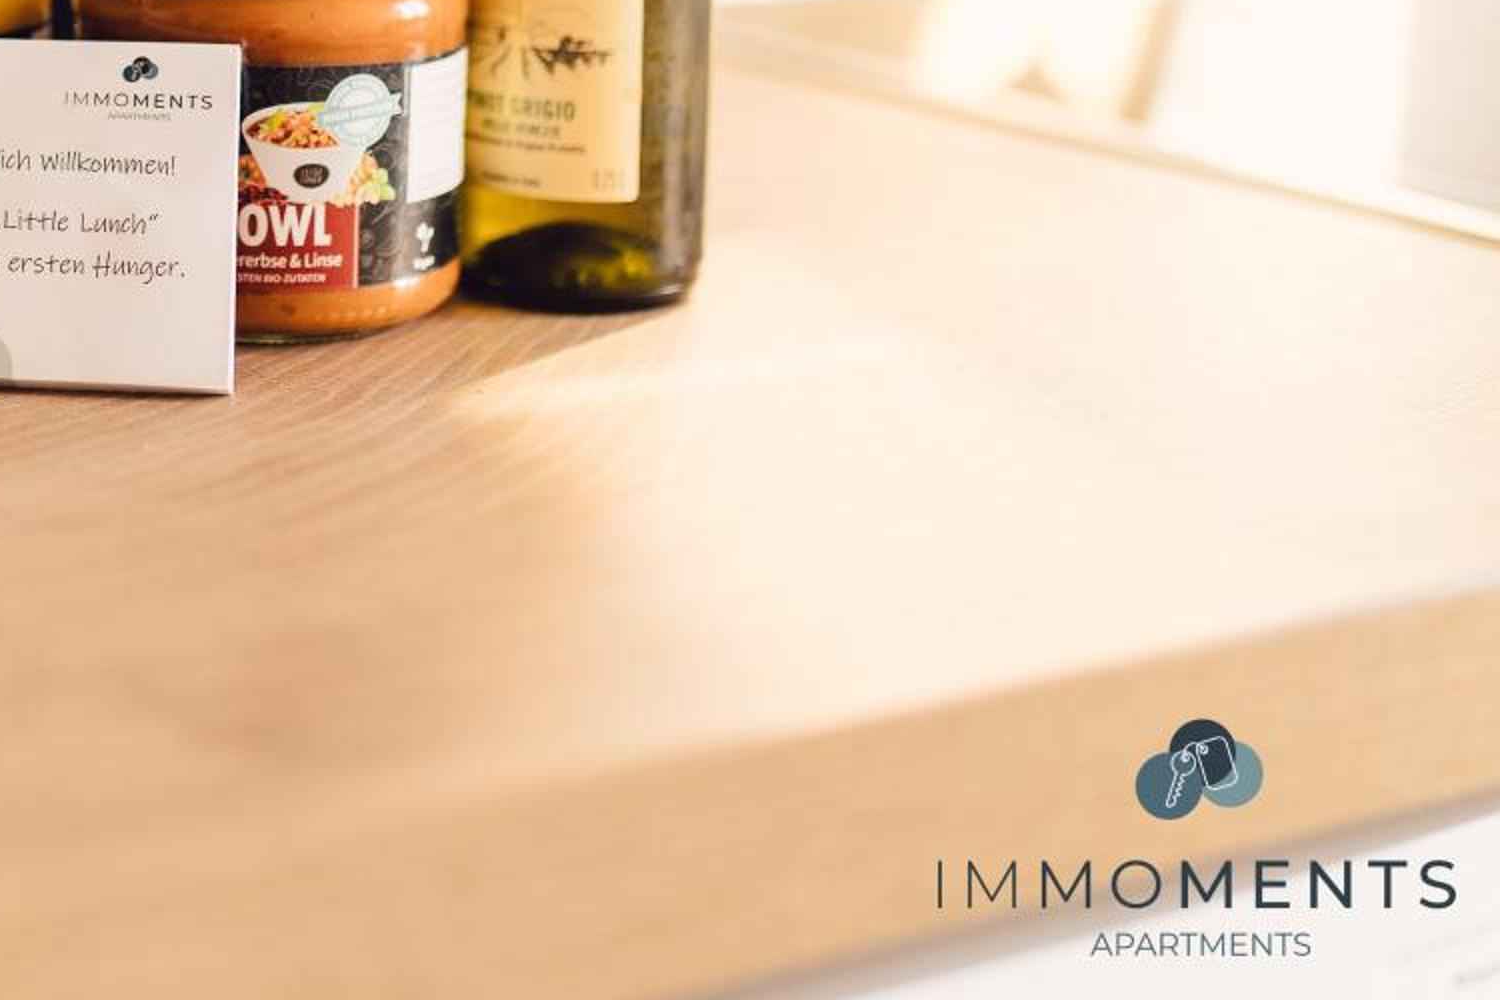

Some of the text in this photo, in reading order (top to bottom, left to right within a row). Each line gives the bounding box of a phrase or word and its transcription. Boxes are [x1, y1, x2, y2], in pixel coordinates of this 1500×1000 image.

[64, 91, 213, 111] IMMOMENTS
[40, 151, 175, 177] Willkommen!
[80, 211, 160, 235] Lunch“
[6, 251, 85, 275] ersten
[91, 250, 186, 285] Hunger.
[237, 252, 343, 268] rerbse & Linse
